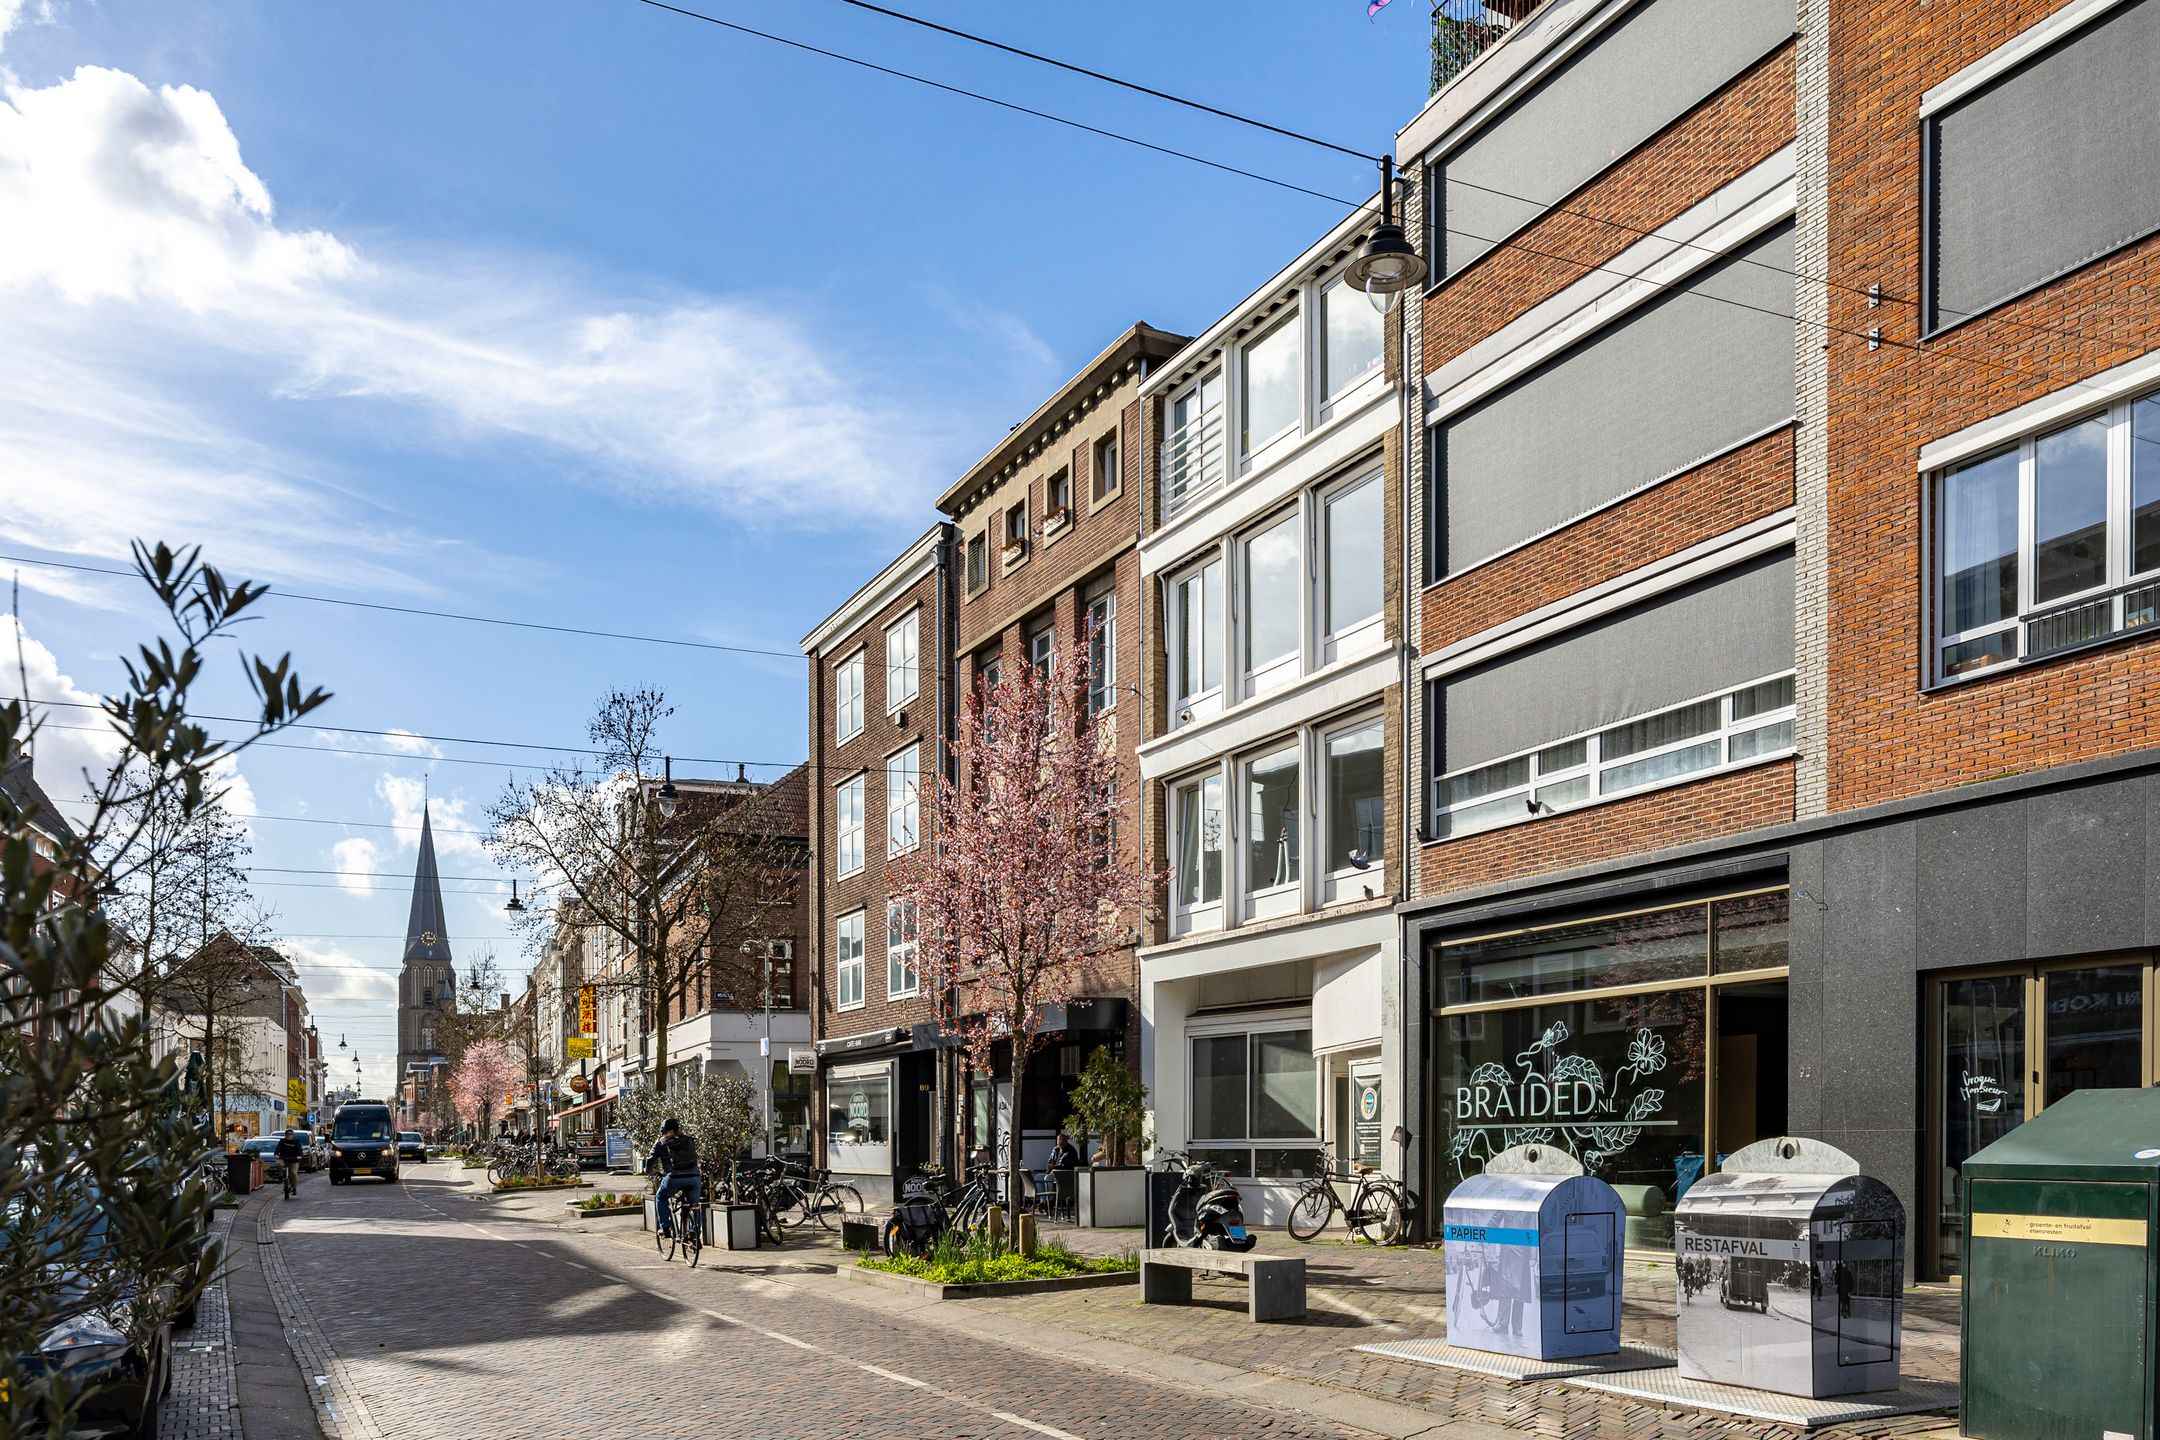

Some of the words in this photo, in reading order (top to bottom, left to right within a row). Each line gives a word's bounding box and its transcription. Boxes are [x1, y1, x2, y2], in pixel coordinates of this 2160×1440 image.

[1962, 1070, 1997, 1089] Croque
[1451, 1227, 1487, 1241] PAPIER
[1685, 1237, 1768, 1256] RESTAFVAL
[2033, 1246, 2077, 1259] KLIKO
